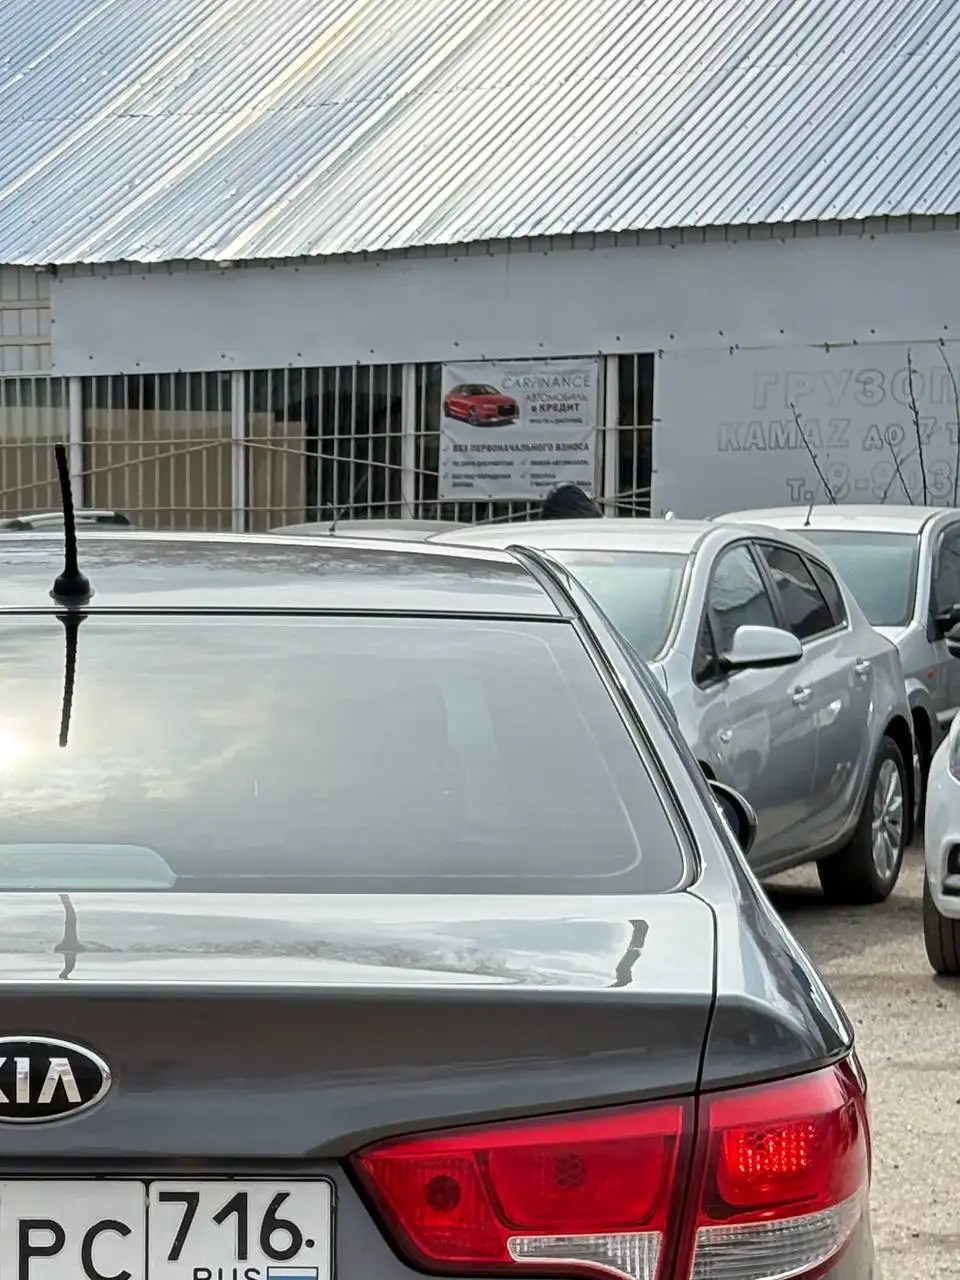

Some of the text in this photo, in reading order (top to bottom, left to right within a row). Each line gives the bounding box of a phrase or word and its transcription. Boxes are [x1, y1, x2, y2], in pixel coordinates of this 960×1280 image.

[539, 402, 580, 413] КРЕДИТ
[717, 418, 850, 451] KAMAZ
[158, 1191, 303, 1261] 716
